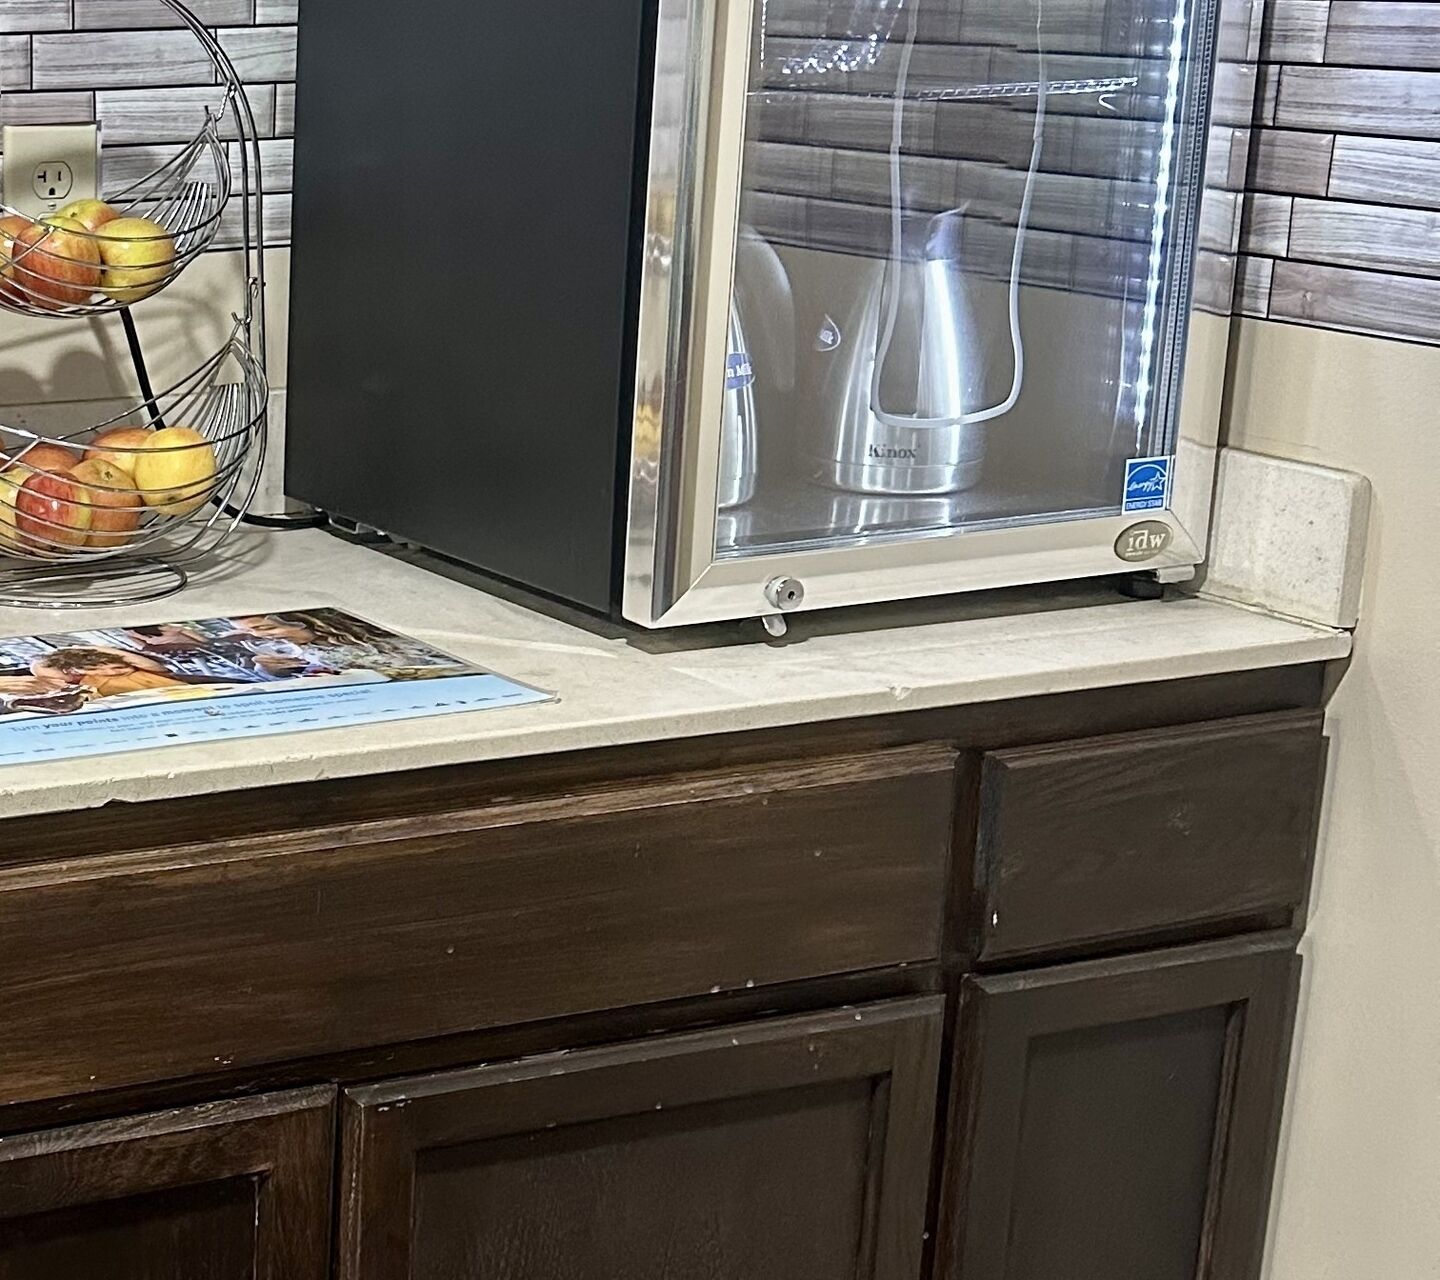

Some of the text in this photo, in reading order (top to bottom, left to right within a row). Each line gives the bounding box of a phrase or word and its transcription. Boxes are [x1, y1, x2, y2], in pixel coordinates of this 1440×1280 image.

[868, 444, 917, 459] Kinox
[1126, 530, 1166, 551] idw
[10, 724, 40, 733] Turn
[42, 721, 73, 729] your
[76, 717, 120, 727] points
[268, 695, 325, 705] someone
